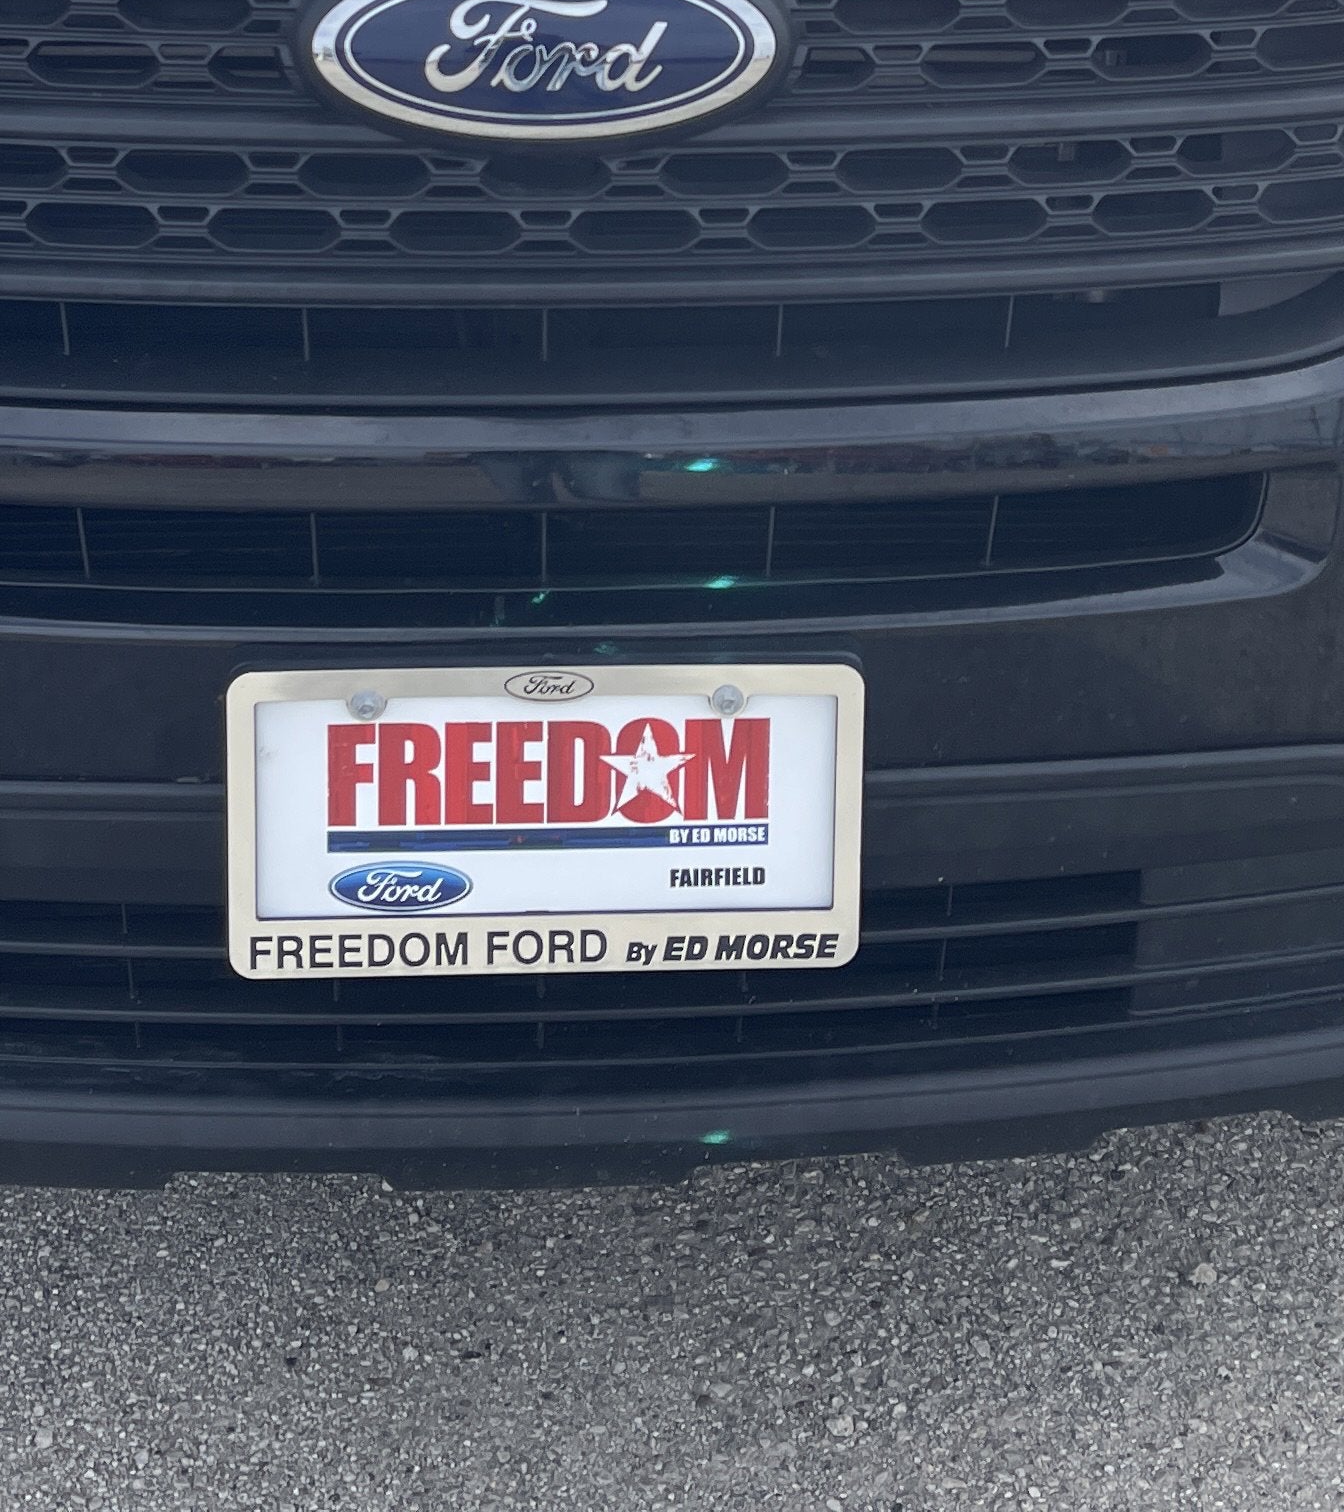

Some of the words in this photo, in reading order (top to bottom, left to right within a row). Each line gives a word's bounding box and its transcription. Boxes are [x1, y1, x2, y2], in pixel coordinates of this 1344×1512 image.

[523, 675, 576, 696] Ford
[326, 717, 771, 827] FREEDOM
[669, 829, 689, 844] BY
[692, 828, 710, 843] ED
[713, 826, 766, 842] MORSE
[357, 868, 444, 903] Ford
[669, 867, 766, 888] FAIRFIELD
[250, 931, 469, 970] FREEDOM
[487, 929, 608, 966] FORD
[625, 942, 658, 966] By
[663, 935, 709, 962] ED
[714, 933, 839, 961] MORSE
